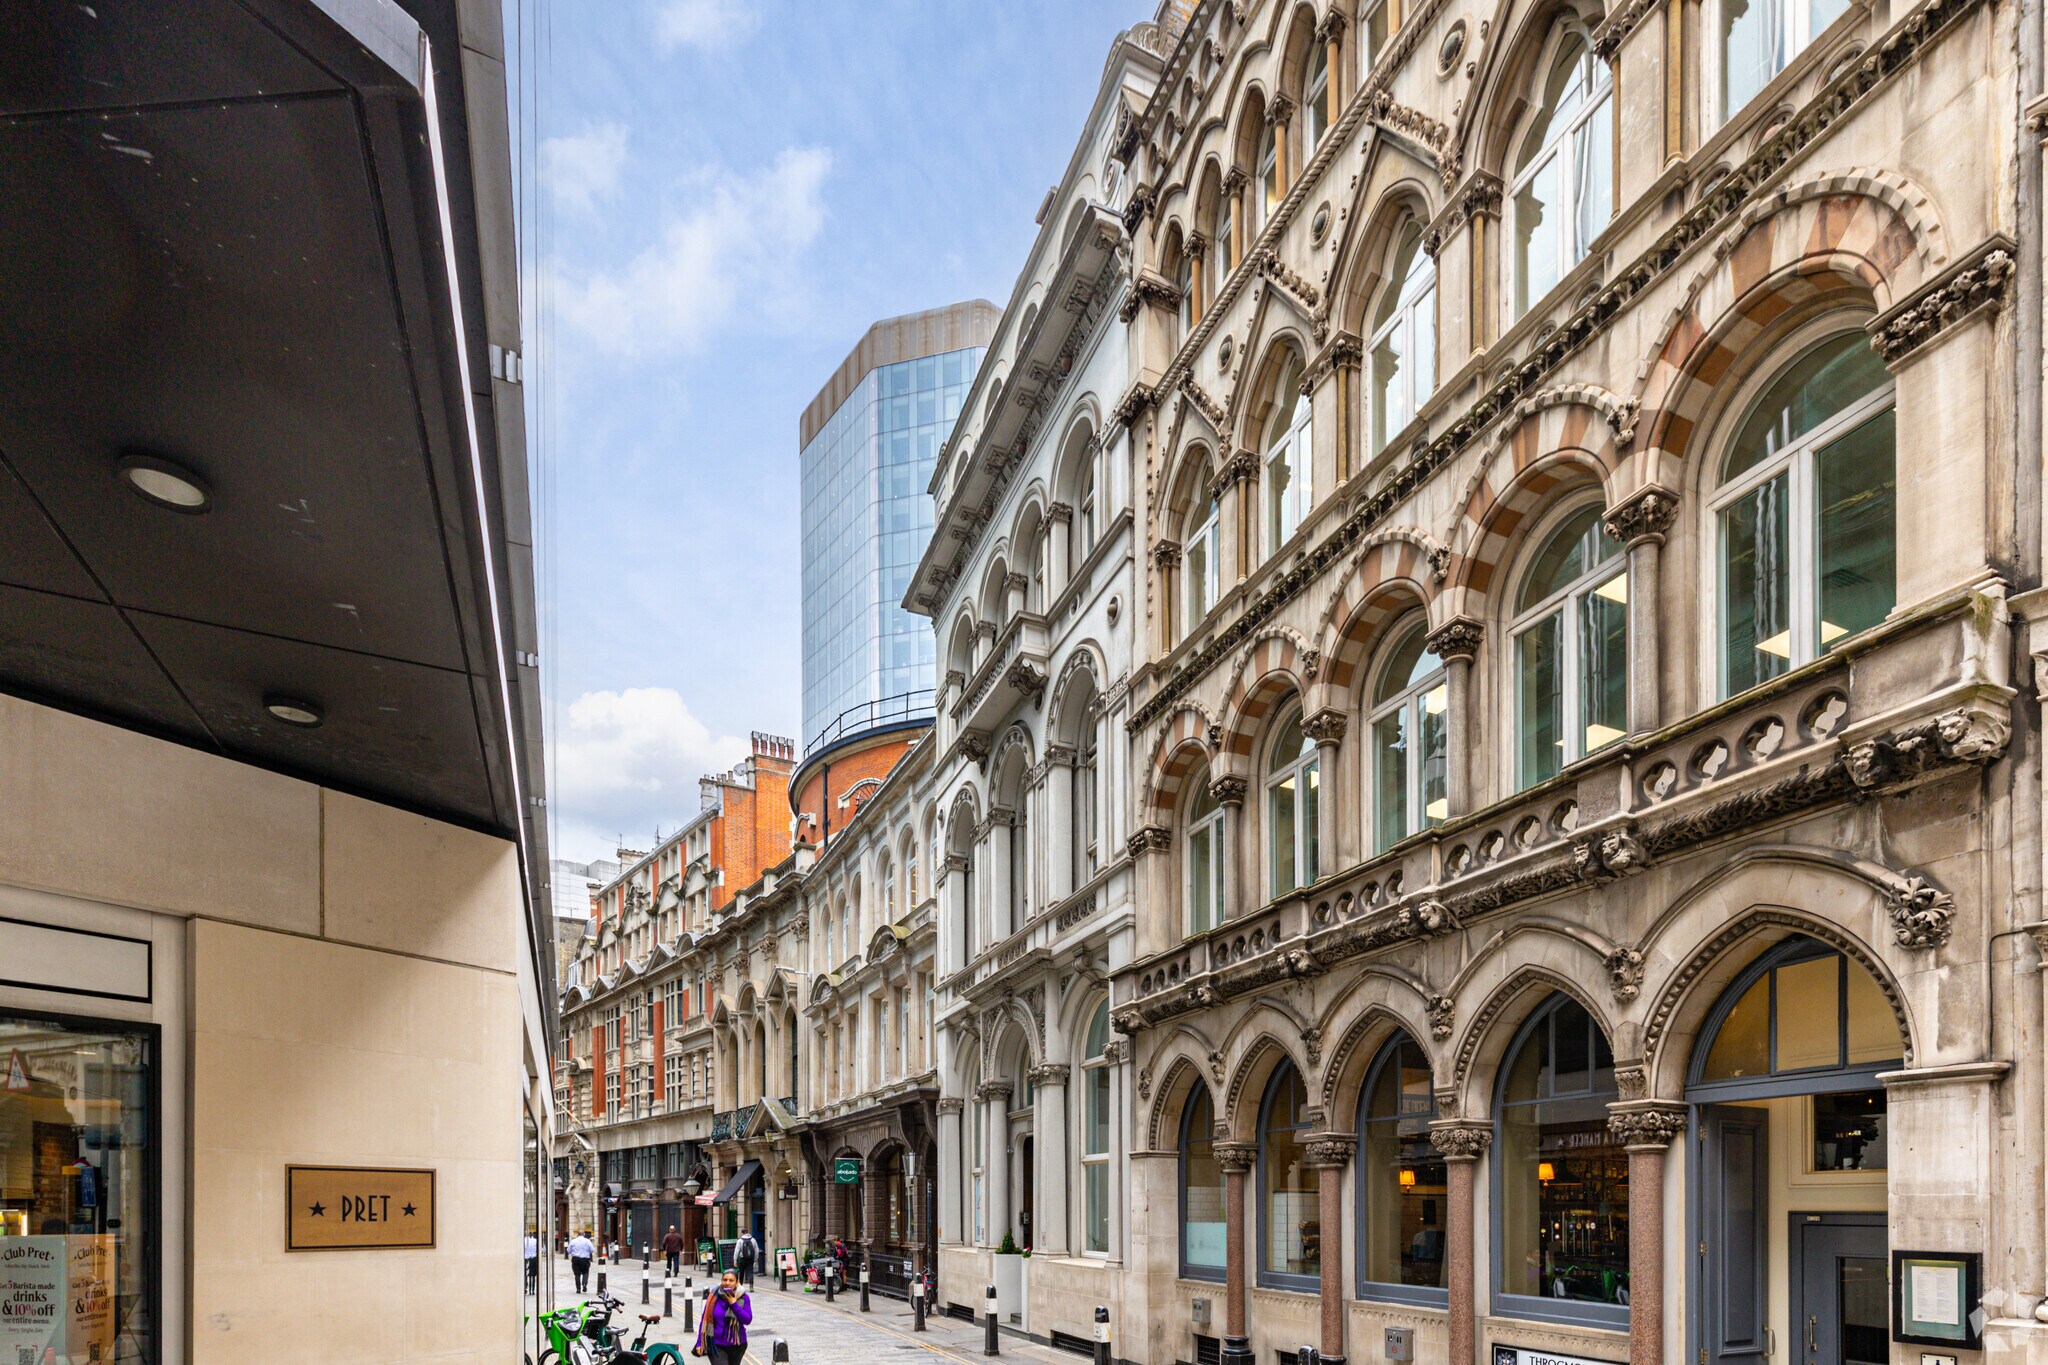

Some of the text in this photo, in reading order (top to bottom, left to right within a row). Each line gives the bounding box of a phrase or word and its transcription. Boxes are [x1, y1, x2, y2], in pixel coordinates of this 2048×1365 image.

[341, 1194, 391, 1222] PRET
[4, 1246, 51, 1261] Club Pret
[77, 1245, 95, 1260] Club
[8, 1280, 13, 1290] 5
[13, 1290, 48, 1302] drinks
[85, 1287, 108, 1299] drinks
[2, 1299, 56, 1316] & 10% off
[75, 1297, 85, 1314] &
[101, 1298, 111, 1310] off
[12, 1316, 32, 1324] entire
